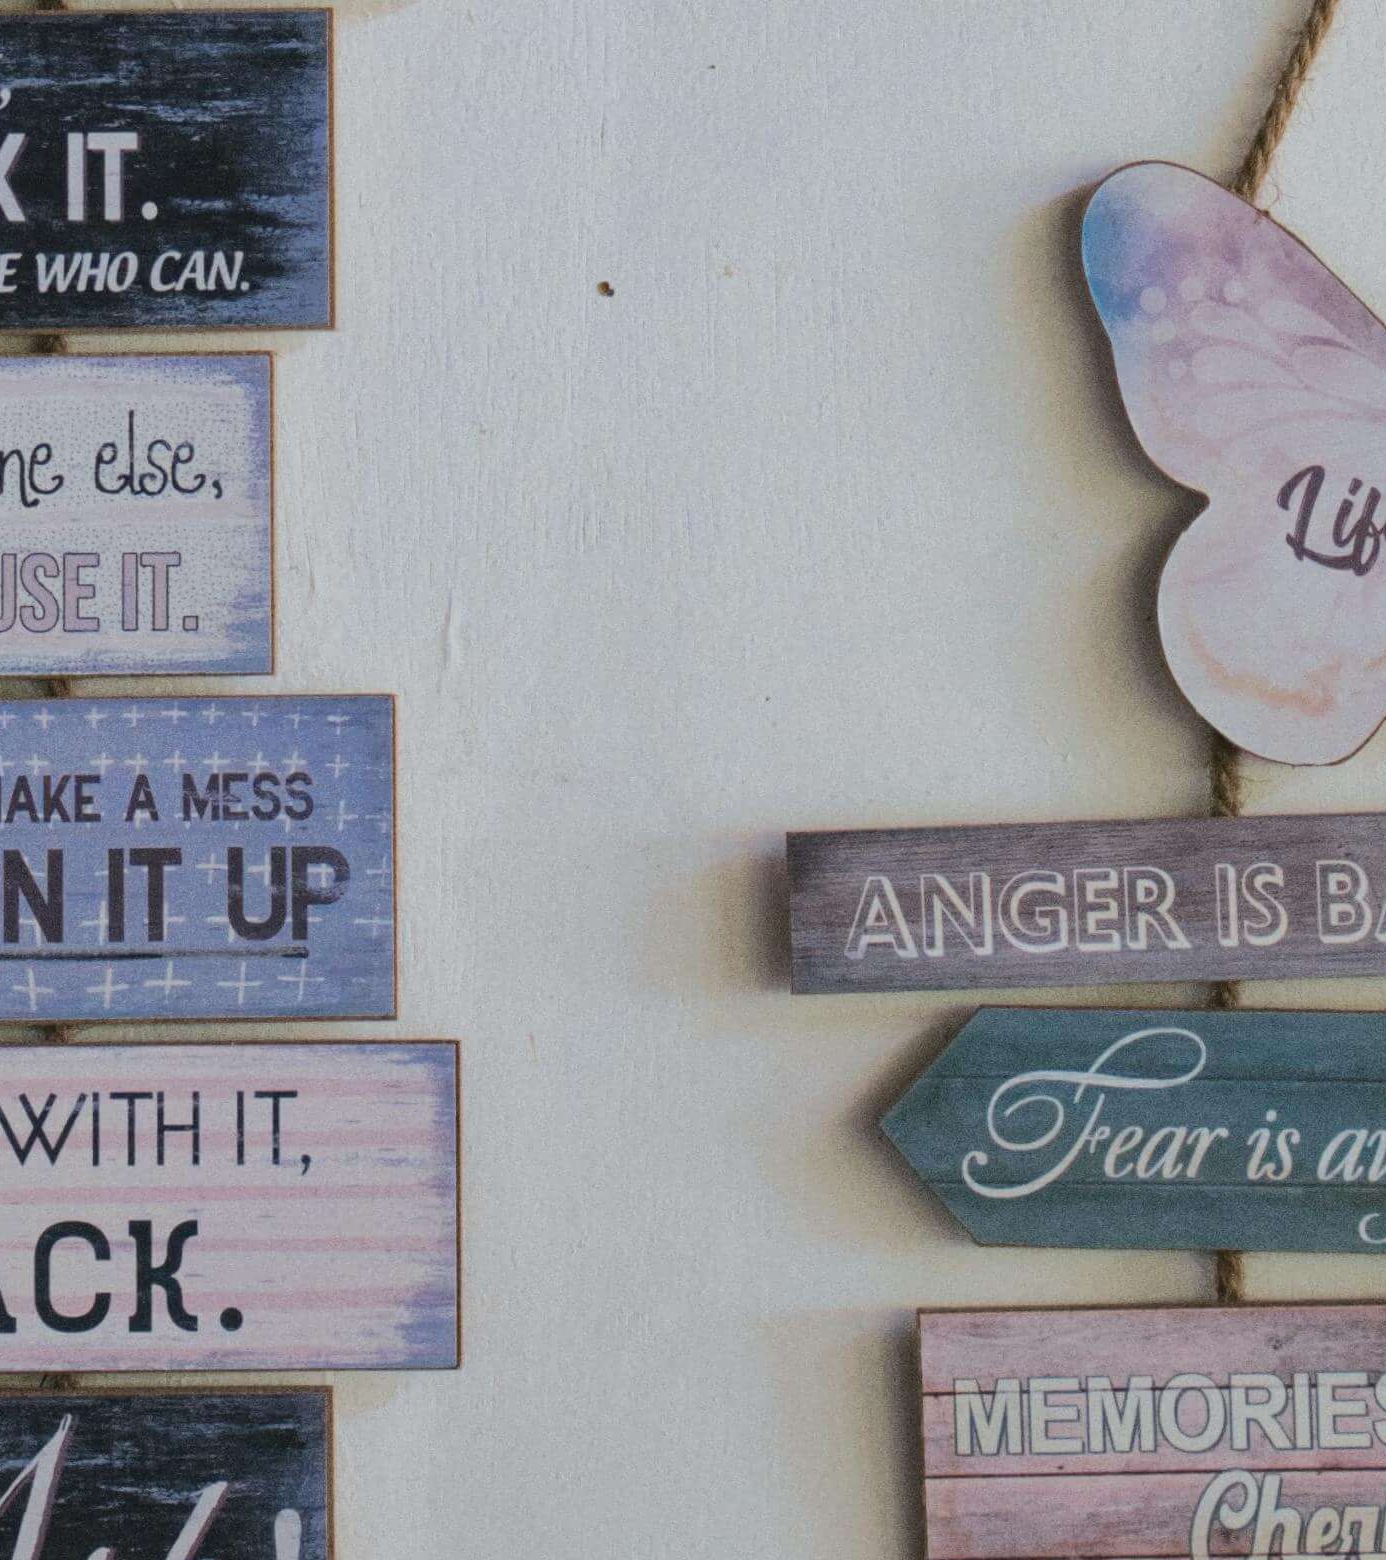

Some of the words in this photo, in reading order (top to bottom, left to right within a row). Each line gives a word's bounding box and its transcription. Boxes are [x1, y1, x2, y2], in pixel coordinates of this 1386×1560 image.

[64, 133, 160, 223] IT.
[34, 252, 139, 296] WHO
[149, 250, 253, 295] CAN.
[91, 410, 225, 503] else,
[122, 551, 201, 634] IT.
[124, 775, 161, 824] A
[179, 772, 316, 824] MESS
[104, 848, 183, 943] IT
[226, 847, 354, 944] UP
[844, 864, 1193, 960] ANGER
[1214, 864, 1288, 950] IS
[234, 1089, 315, 1177] IT,
[959, 1025, 1231, 1200] Fear
[1244, 1108, 1303, 1182] is
